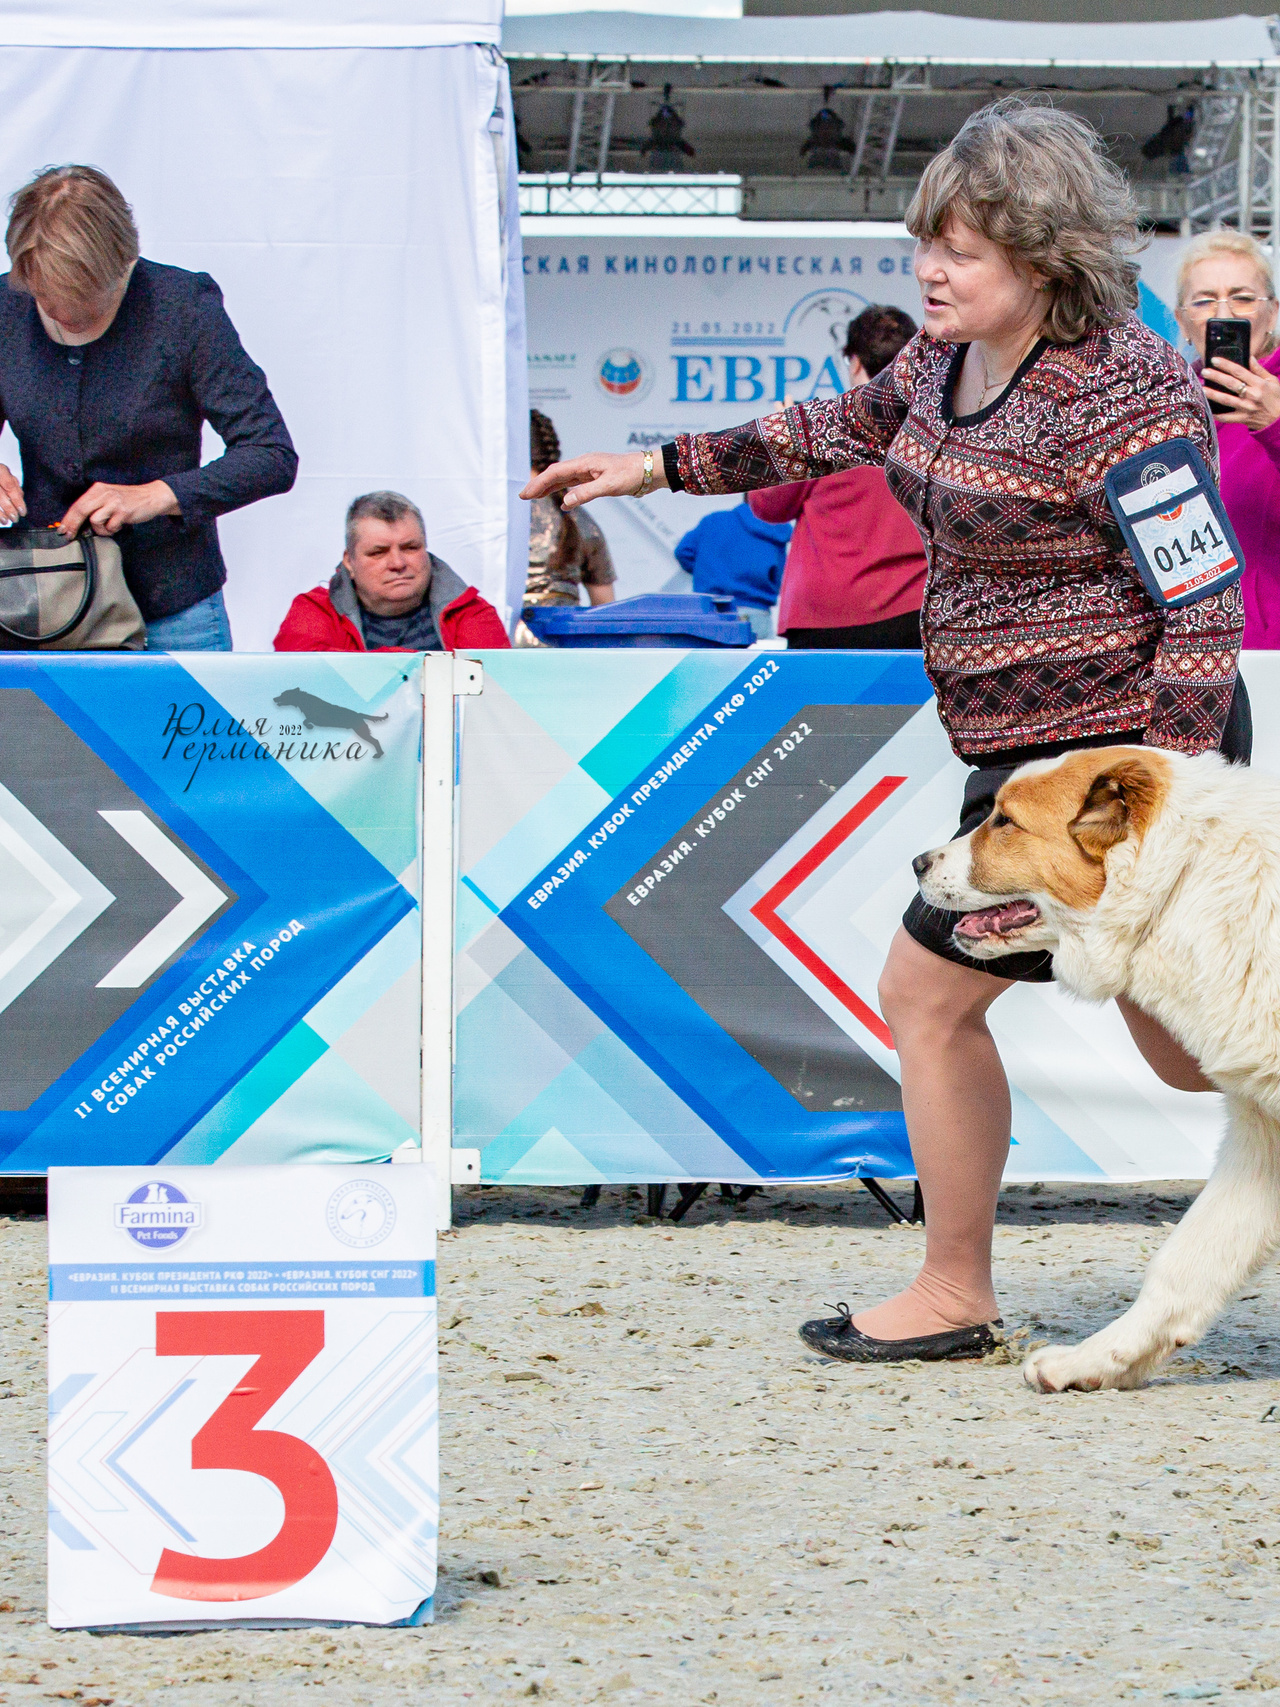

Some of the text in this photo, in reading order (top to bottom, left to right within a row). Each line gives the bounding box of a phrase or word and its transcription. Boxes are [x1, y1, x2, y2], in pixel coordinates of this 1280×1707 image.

[604, 255, 863, 275] КИНОЛОГИЧЕСКАЯ
[670, 354, 846, 403] ЕВРА
[1153, 521, 1223, 573] 0141
[1183, 566, 1222, 590] 21.05.2022
[527, 660, 780, 910] ЕВРАЗИЯ. КУБОК ПРЕЗИДЕНТА РКФ 2022
[626, 722, 813, 907] ЕВРАЗИЯ. КУБОК СНГ 2022
[91, 1014, 180, 1102] ВСЕМИРНАЯ
[177, 939, 258, 1016] ВЫСТАВКА
[106, 918, 305, 1115] СОБАК РОССИЙСКИХ ПОРОД
[120, 1206, 195, 1224] Farmina
[137, 1230, 151, 1240] Pet
[68, 1269, 418, 1283] «ЕВРАЗИЯ. КУБОК ПРЕЗИДЕНТА РКФ 2022» «ЕВРАЗИЯ. КУБОК СНГ 2022»
[120, 1283, 181, 1294] ВСЕМИРНАЯ
[182, 1283, 235, 1293] ВЫСТАВКА
[237, 1282, 270, 1292] СОБАК
[273, 1280, 339, 1292] РОССИЙСКИХ
[340, 1282, 376, 1292] ПОРОД
[149, 1310, 339, 1602] 3
